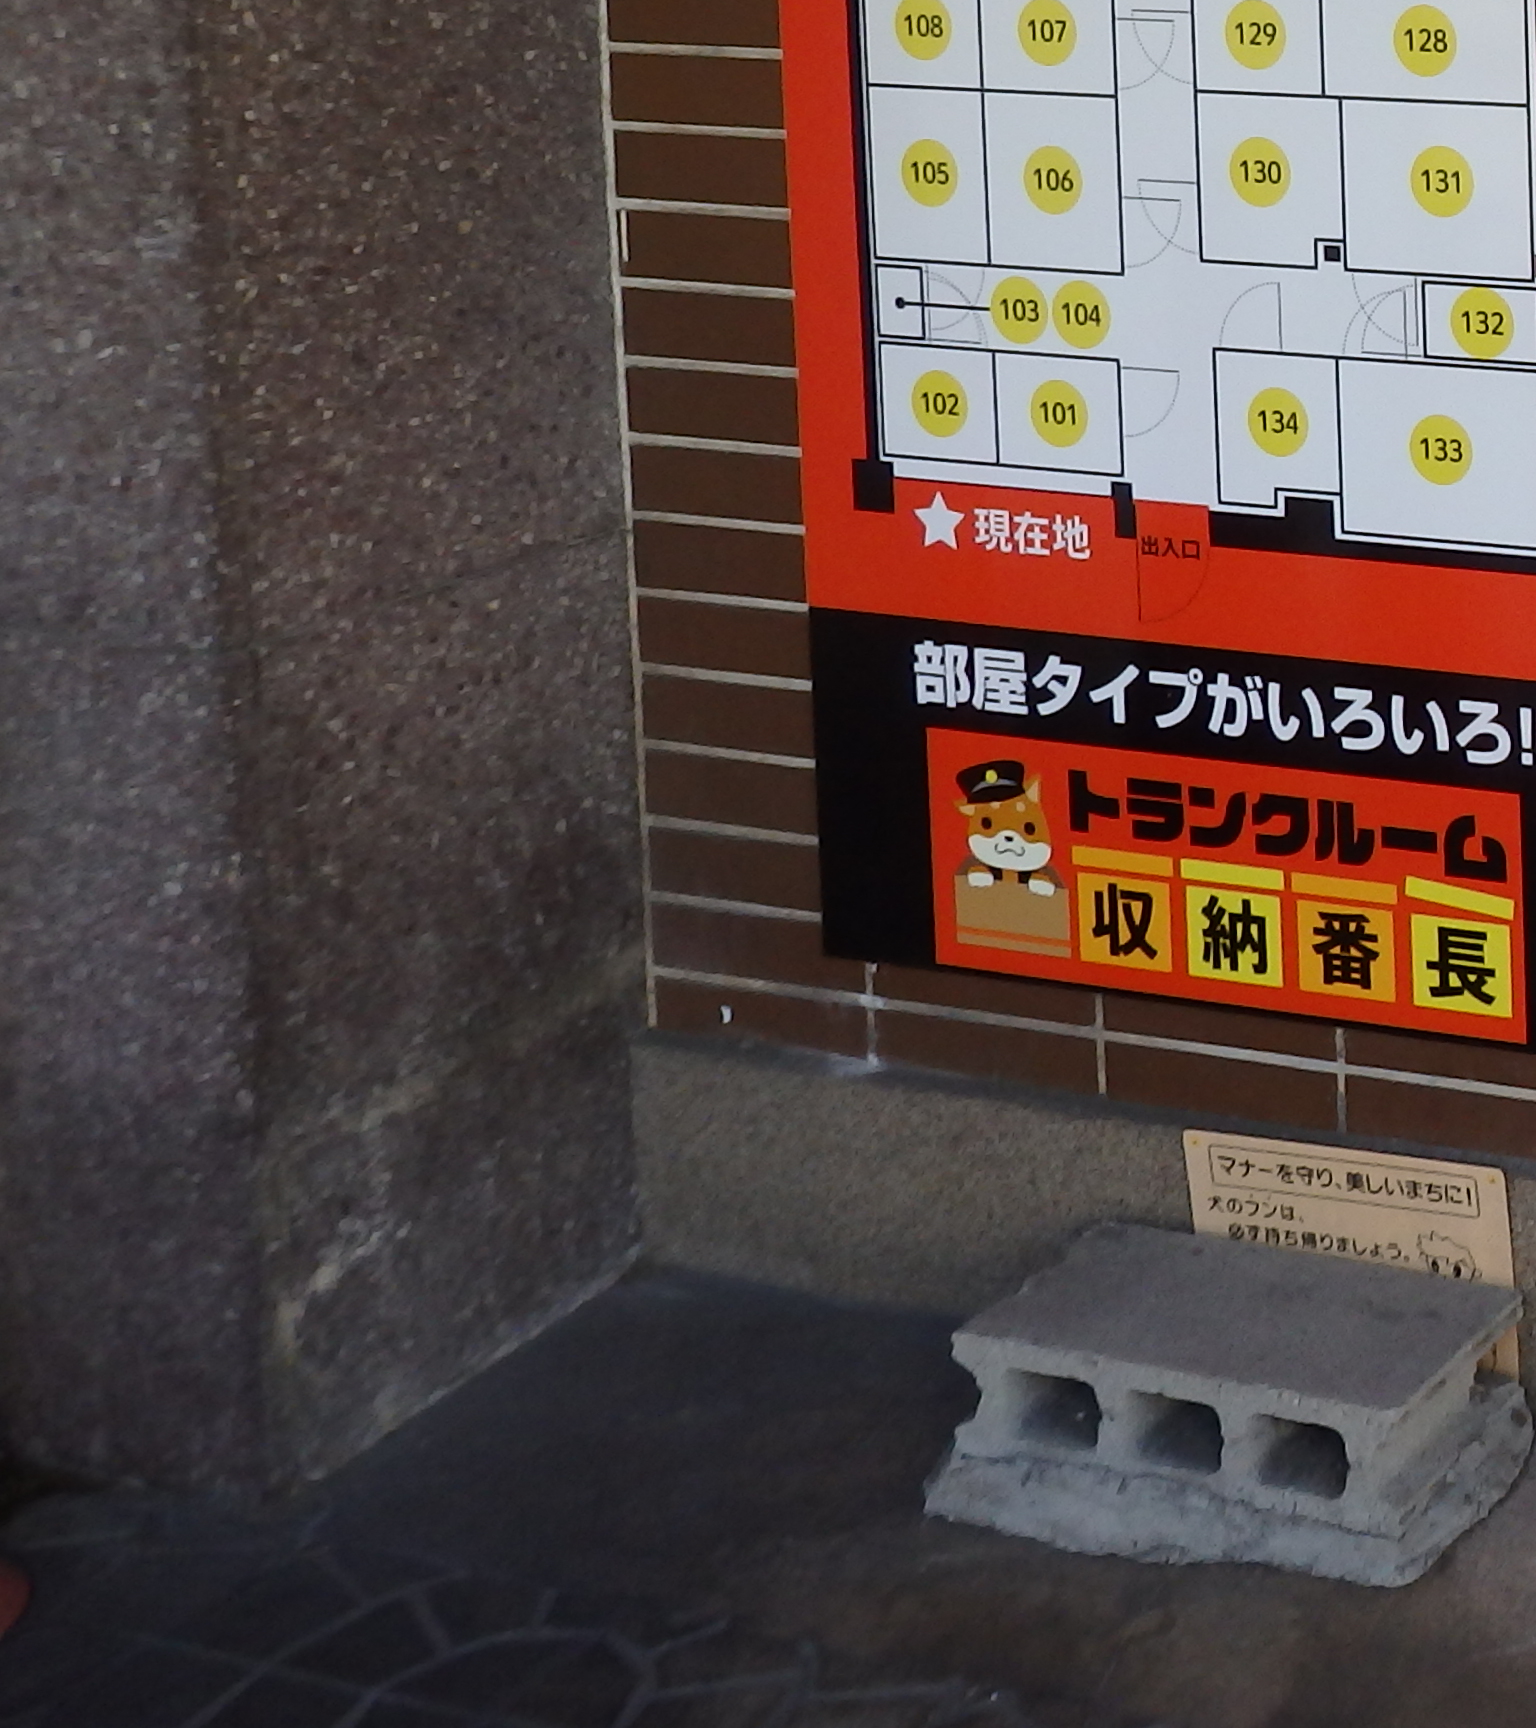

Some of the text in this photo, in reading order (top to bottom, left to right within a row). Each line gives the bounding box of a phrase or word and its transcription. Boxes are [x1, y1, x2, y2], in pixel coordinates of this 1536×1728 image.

[904, 14, 943, 38] 108
[1028, 19, 1066, 42] 107
[1235, 22, 1276, 45] 129
[1404, 29, 1447, 53] 128
[911, 161, 949, 185] 105
[1034, 168, 1073, 192] 106
[1240, 160, 1281, 184] 130
[1421, 169, 1460, 193] 131
[1000, 299, 1039, 322] 103
[1062, 303, 1100, 326] 104
[1462, 311, 1504, 335] 132
[922, 392, 959, 416] 102
[1040, 402, 1075, 425] 101
[1258, 410, 1298, 434] 134
[1420, 438, 1462, 462] 133
[974, 509, 1090, 559] 現在地
[1141, 536, 1200, 560] 出入口
[1071, 773, 1508, 880] トランクルーム
[1091, 884, 1498, 1007] 収納番長
